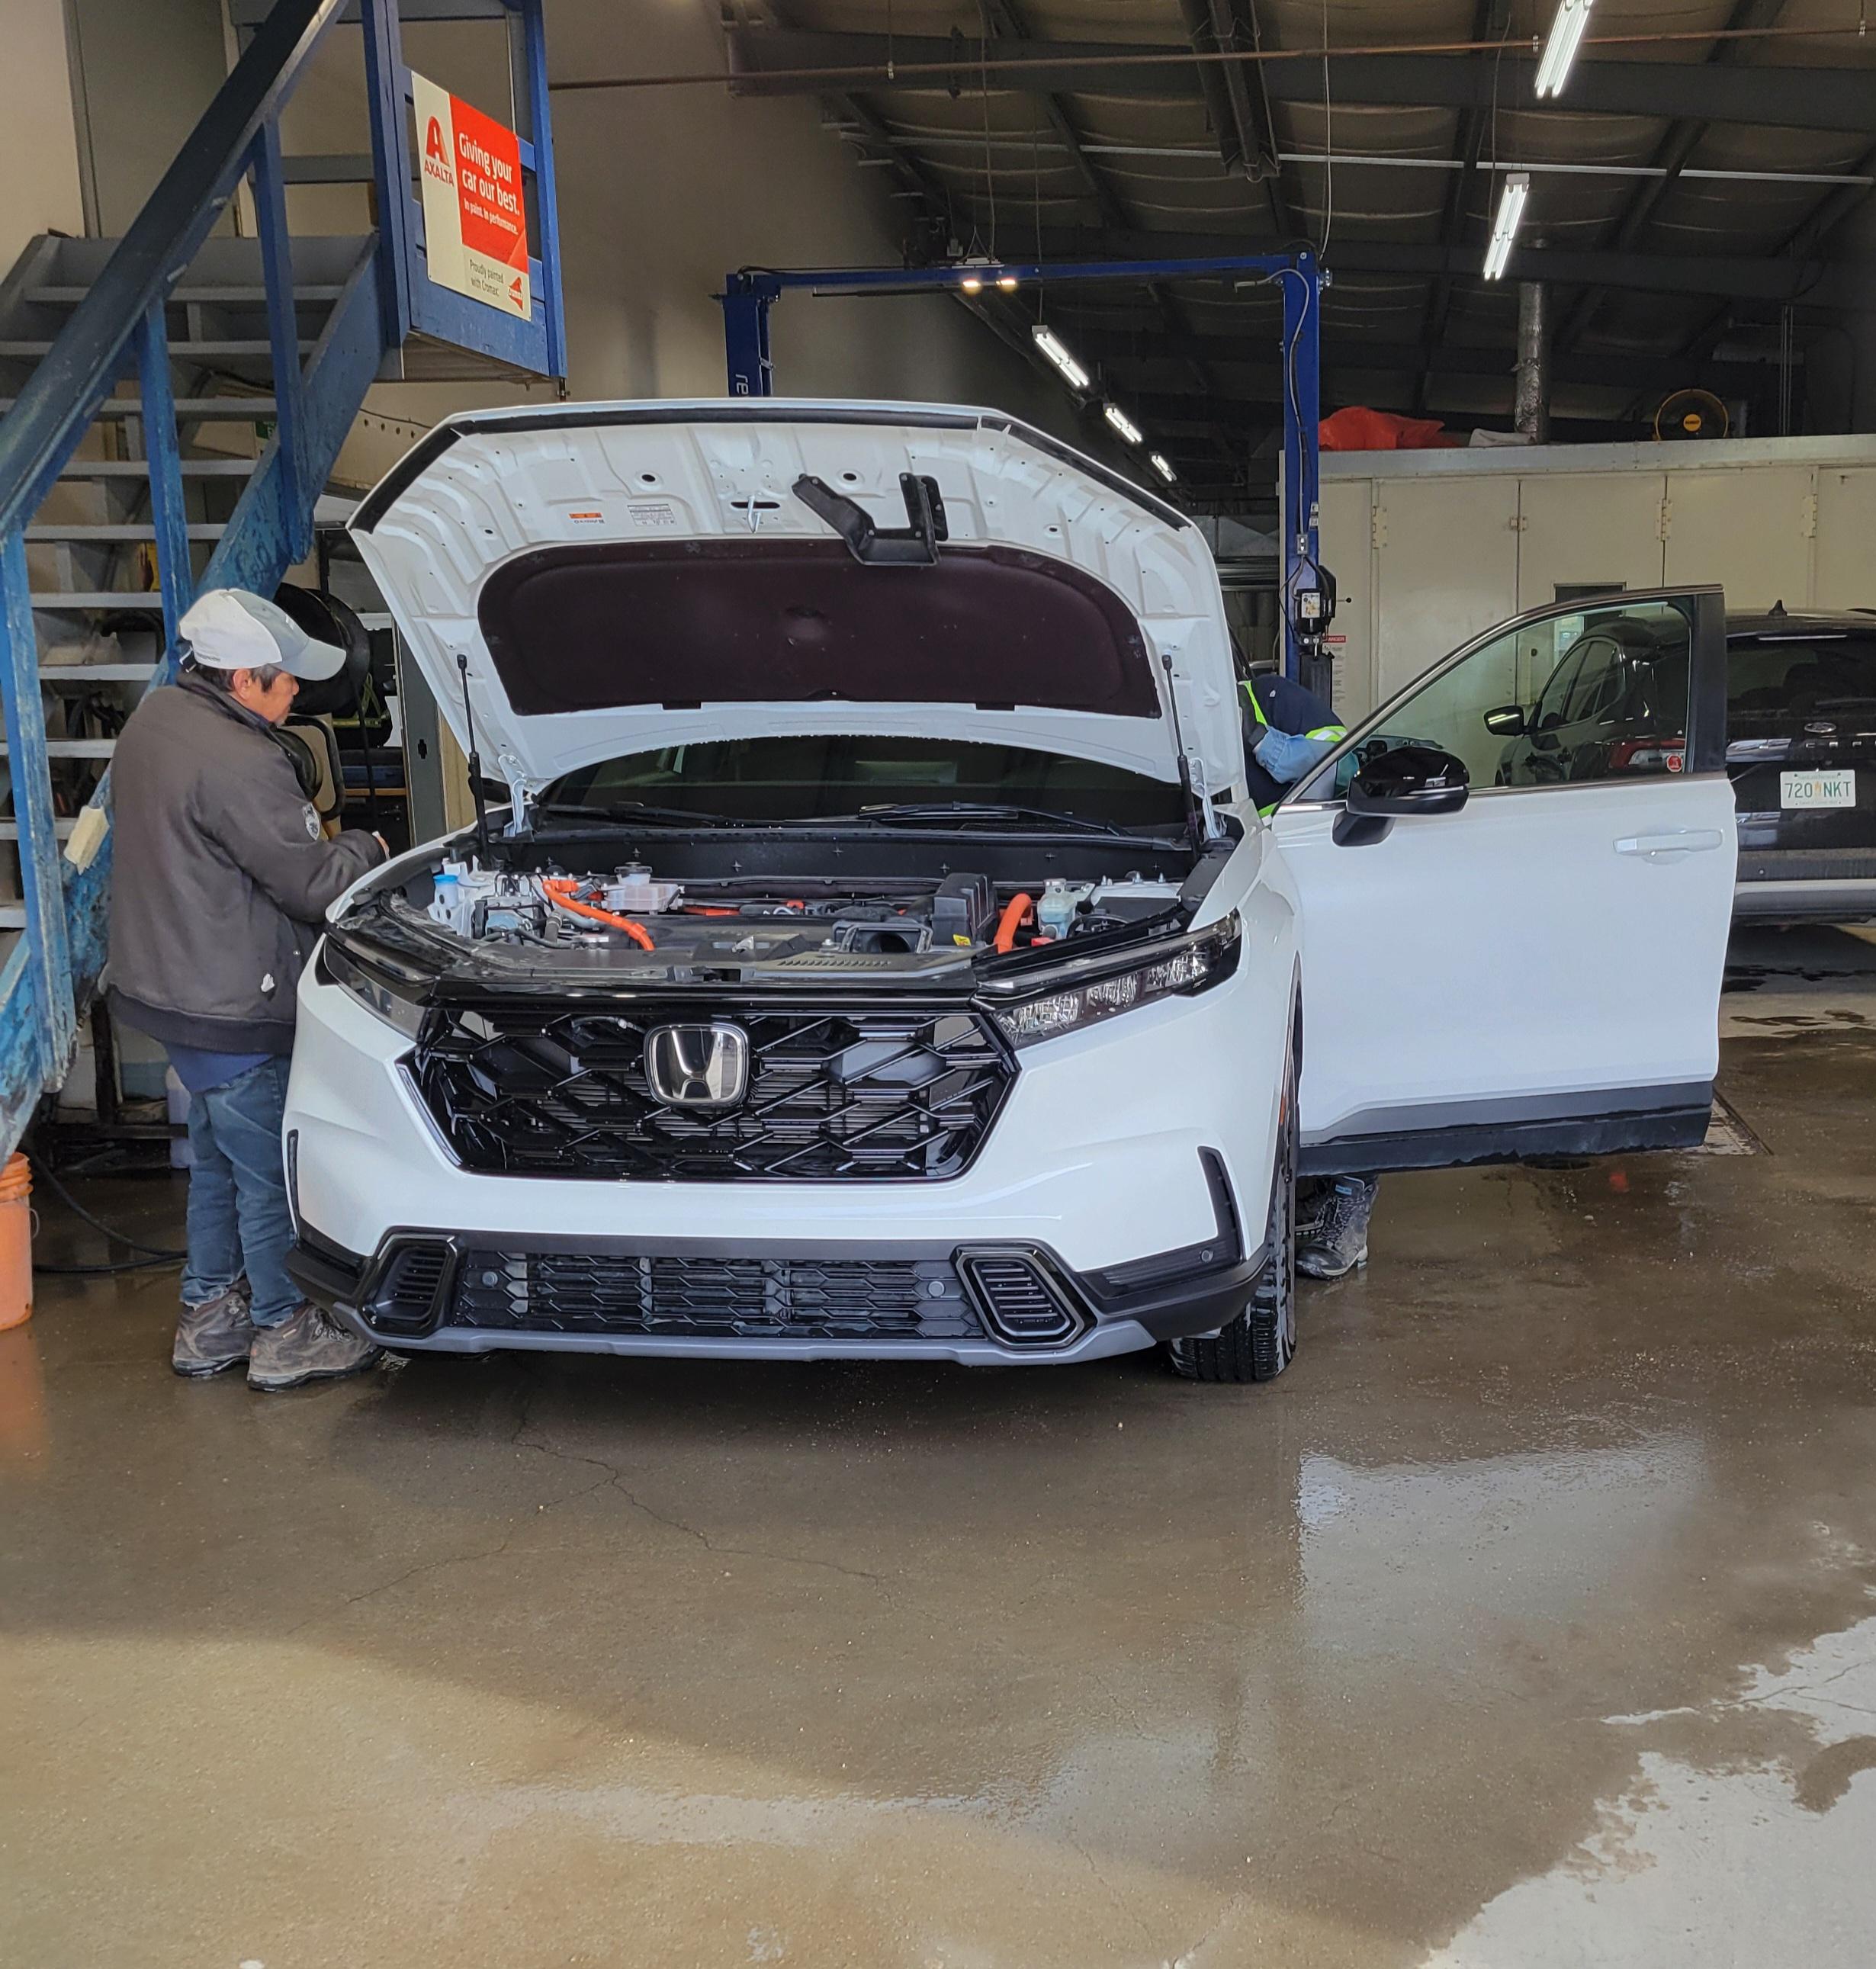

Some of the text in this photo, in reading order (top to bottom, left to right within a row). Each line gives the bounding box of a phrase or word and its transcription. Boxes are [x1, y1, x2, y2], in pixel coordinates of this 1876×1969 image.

[424, 159, 454, 187] AXALTA
[459, 133, 512, 183] Giving your
[462, 169, 519, 216] car our best.
[1784, 781, 1852, 799] 720 NKT
